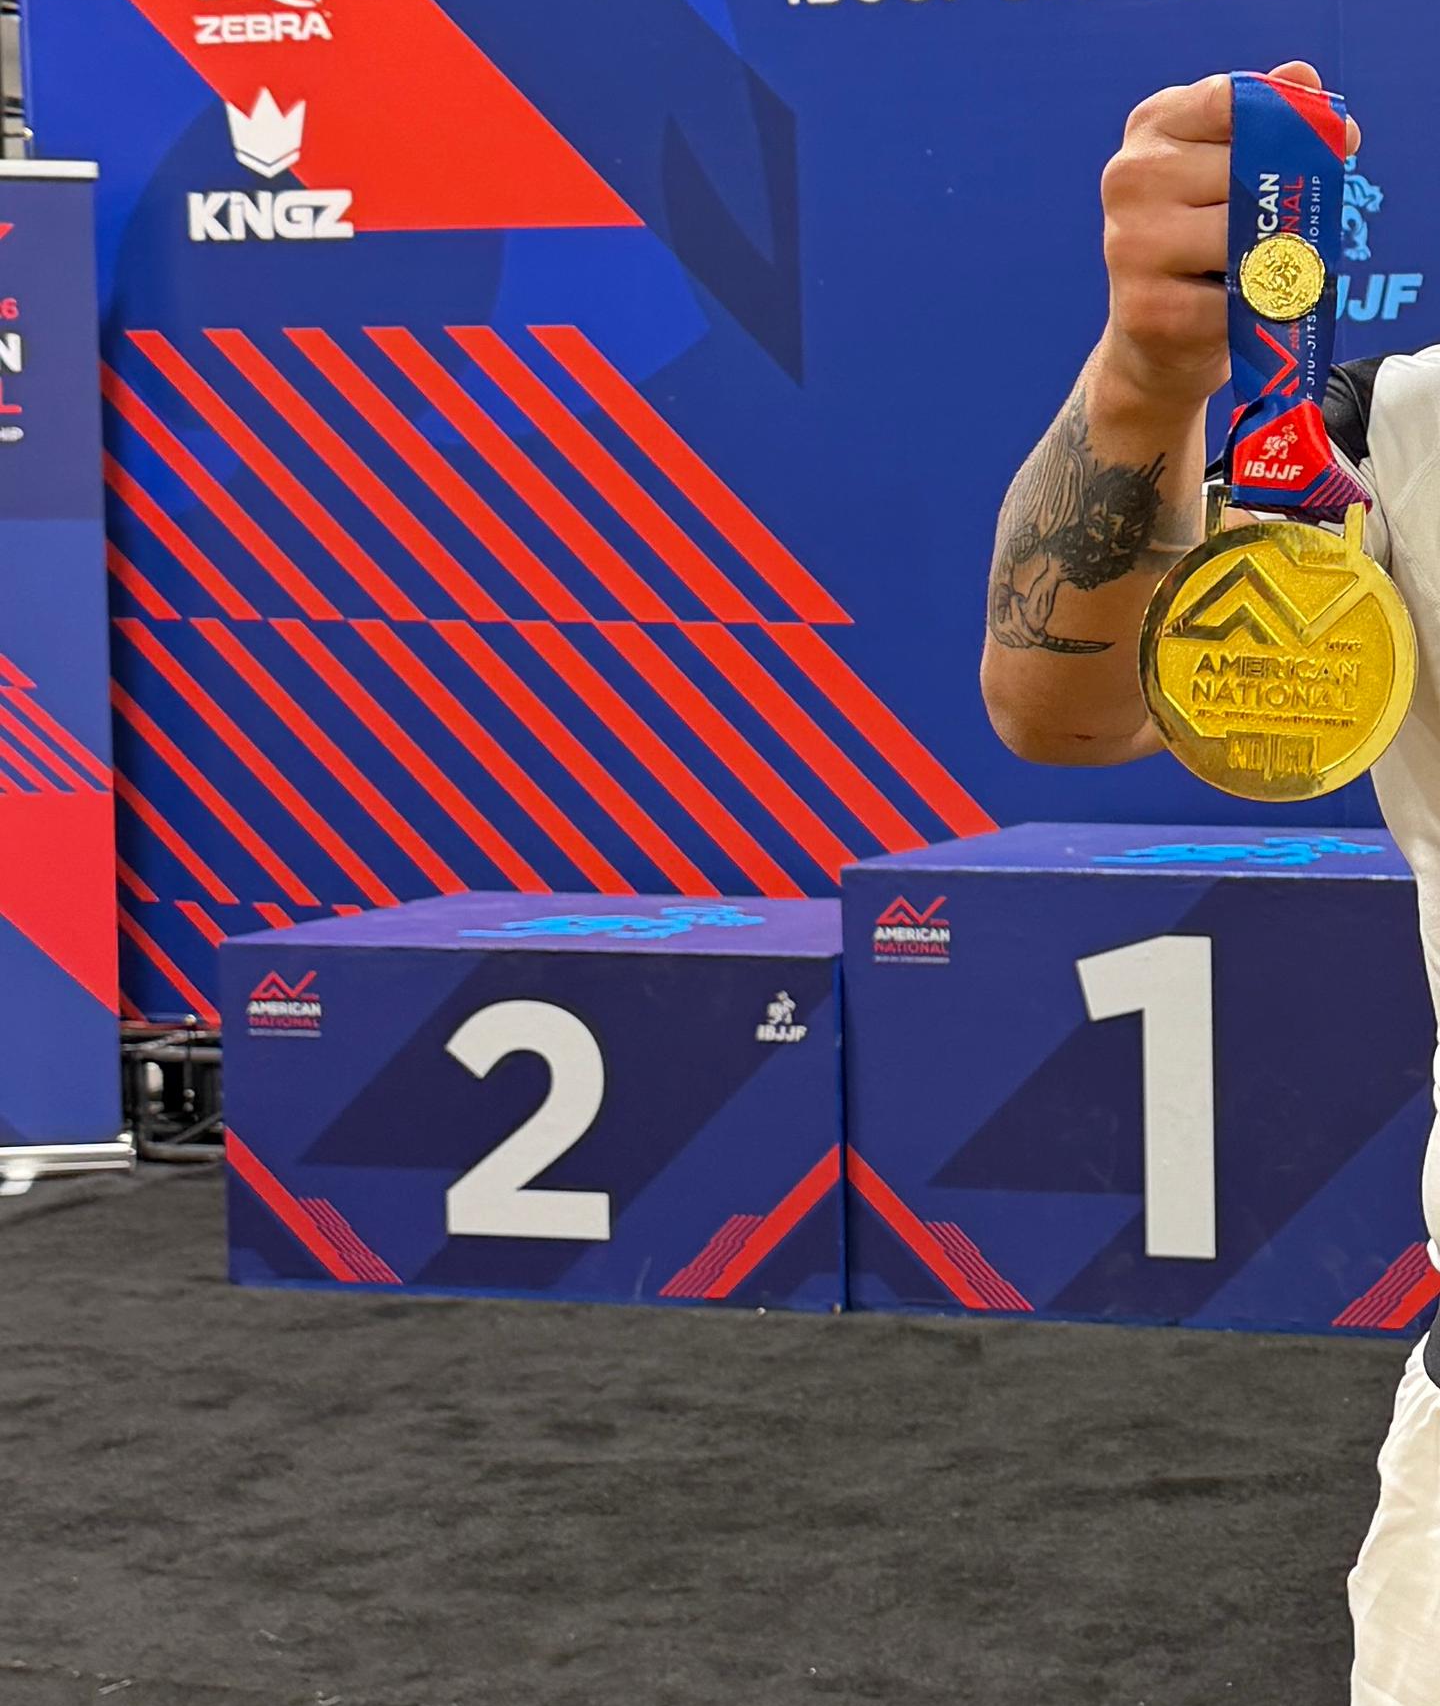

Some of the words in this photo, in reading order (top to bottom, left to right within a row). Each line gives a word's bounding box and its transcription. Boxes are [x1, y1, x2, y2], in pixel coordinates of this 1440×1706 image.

[194, 11, 333, 45] ZEBRA
[1244, 460, 1304, 481] IBJJF
[1194, 652, 1361, 686] AMERICAN
[1191, 678, 1358, 711] NATIONAL
[874, 925, 951, 943] AMERICAN
[755, 1024, 808, 1042] IBJJF
[1077, 935, 1216, 1258] 1
[447, 1000, 610, 1240] 2
